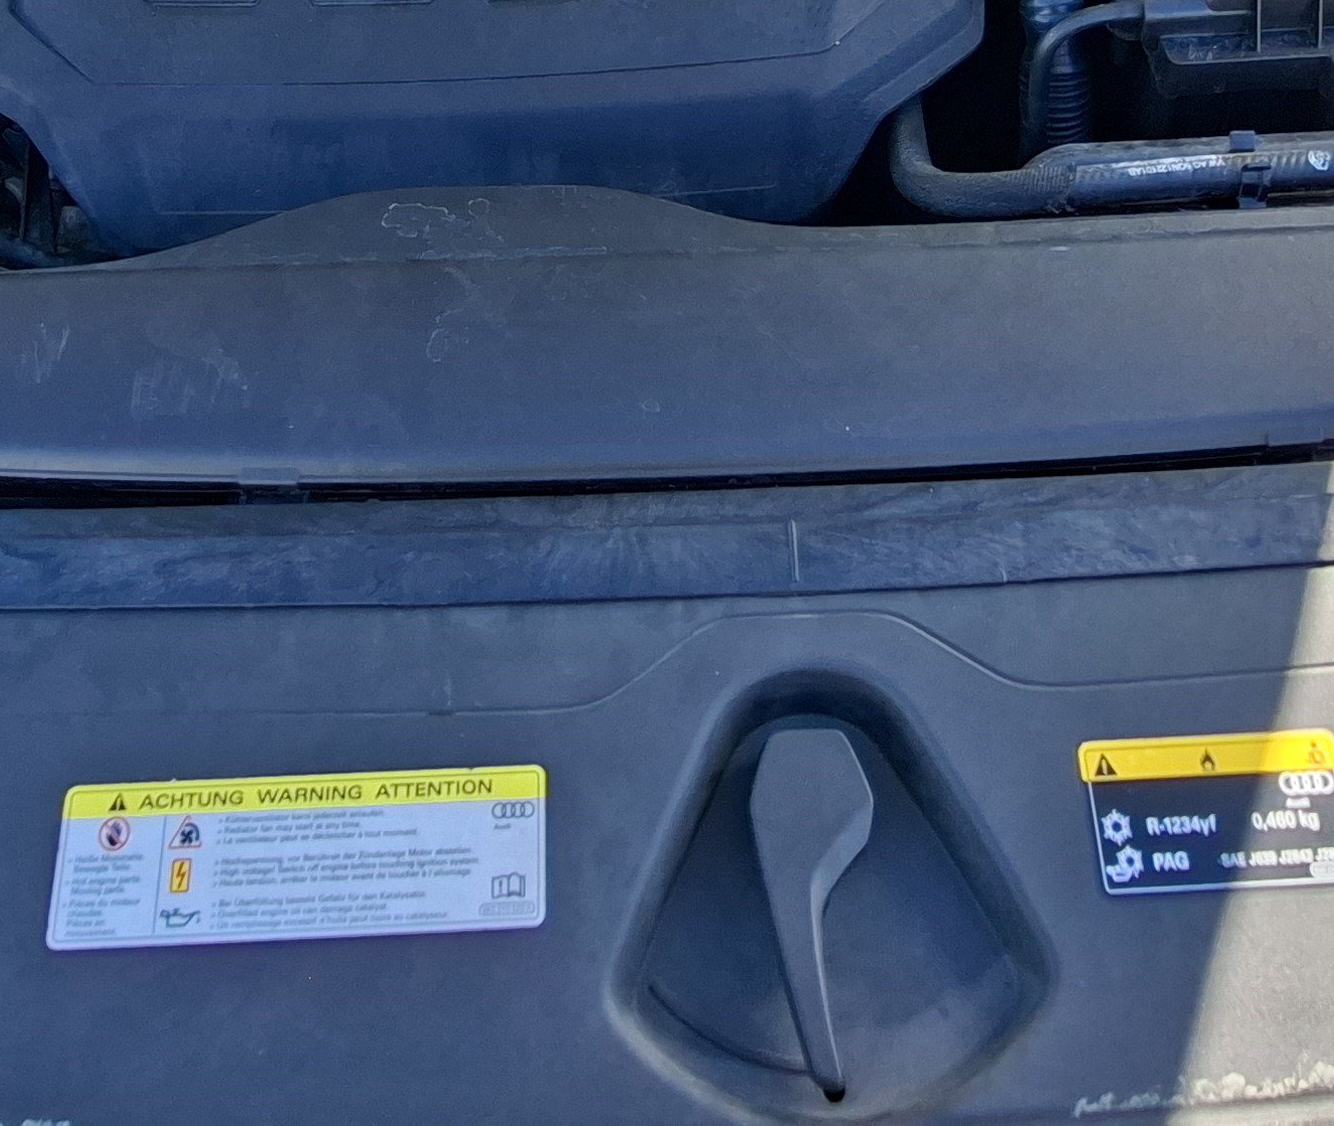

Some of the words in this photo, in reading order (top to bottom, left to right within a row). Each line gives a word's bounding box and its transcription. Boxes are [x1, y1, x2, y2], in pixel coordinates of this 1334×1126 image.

[139, 789, 244, 811] ACHTUNG
[257, 785, 363, 806] WARNING
[375, 779, 494, 800] ATTENTION
[1145, 814, 1216, 837] R-1234yf
[1251, 810, 1297, 832] 0,460
[1298, 810, 1320, 831] kg
[1152, 851, 1190, 872] PAG
